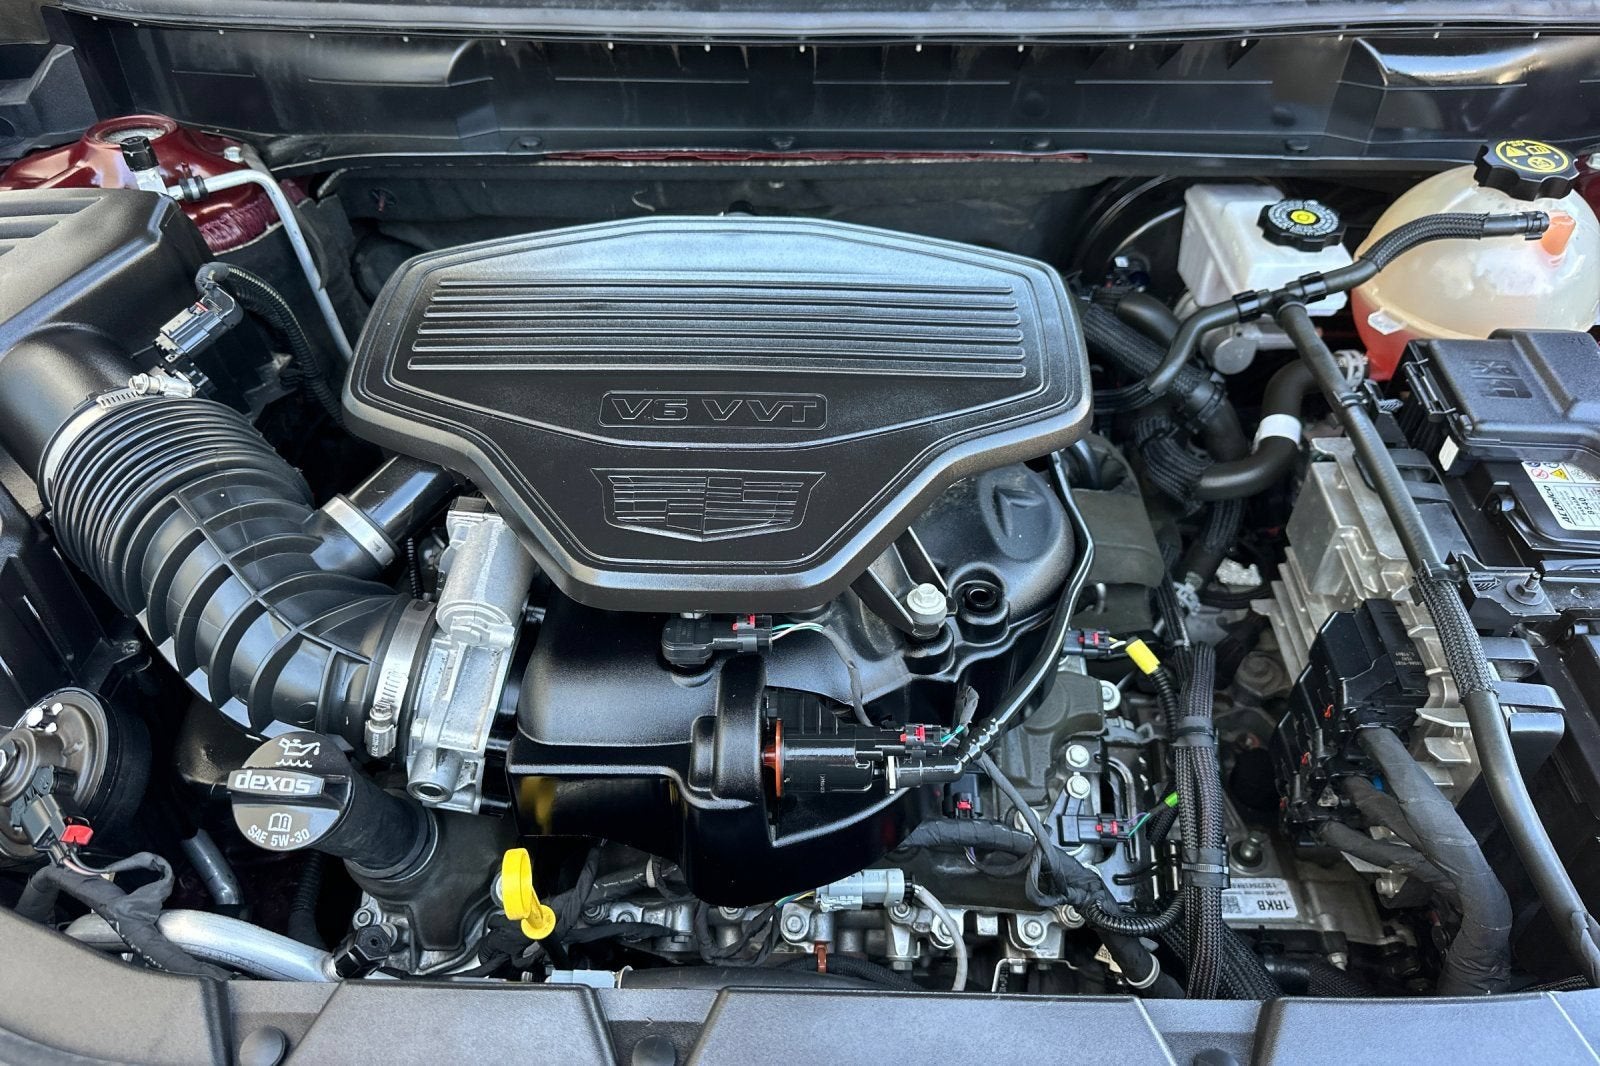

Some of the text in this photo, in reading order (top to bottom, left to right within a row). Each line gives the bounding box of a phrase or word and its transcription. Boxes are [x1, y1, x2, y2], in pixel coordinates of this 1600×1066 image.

[611, 398, 817, 423] V6 VVT
[234, 769, 313, 794] dexos
[247, 824, 311, 847] SAE 5W-30
[1257, 899, 1291, 911] 1RKB
